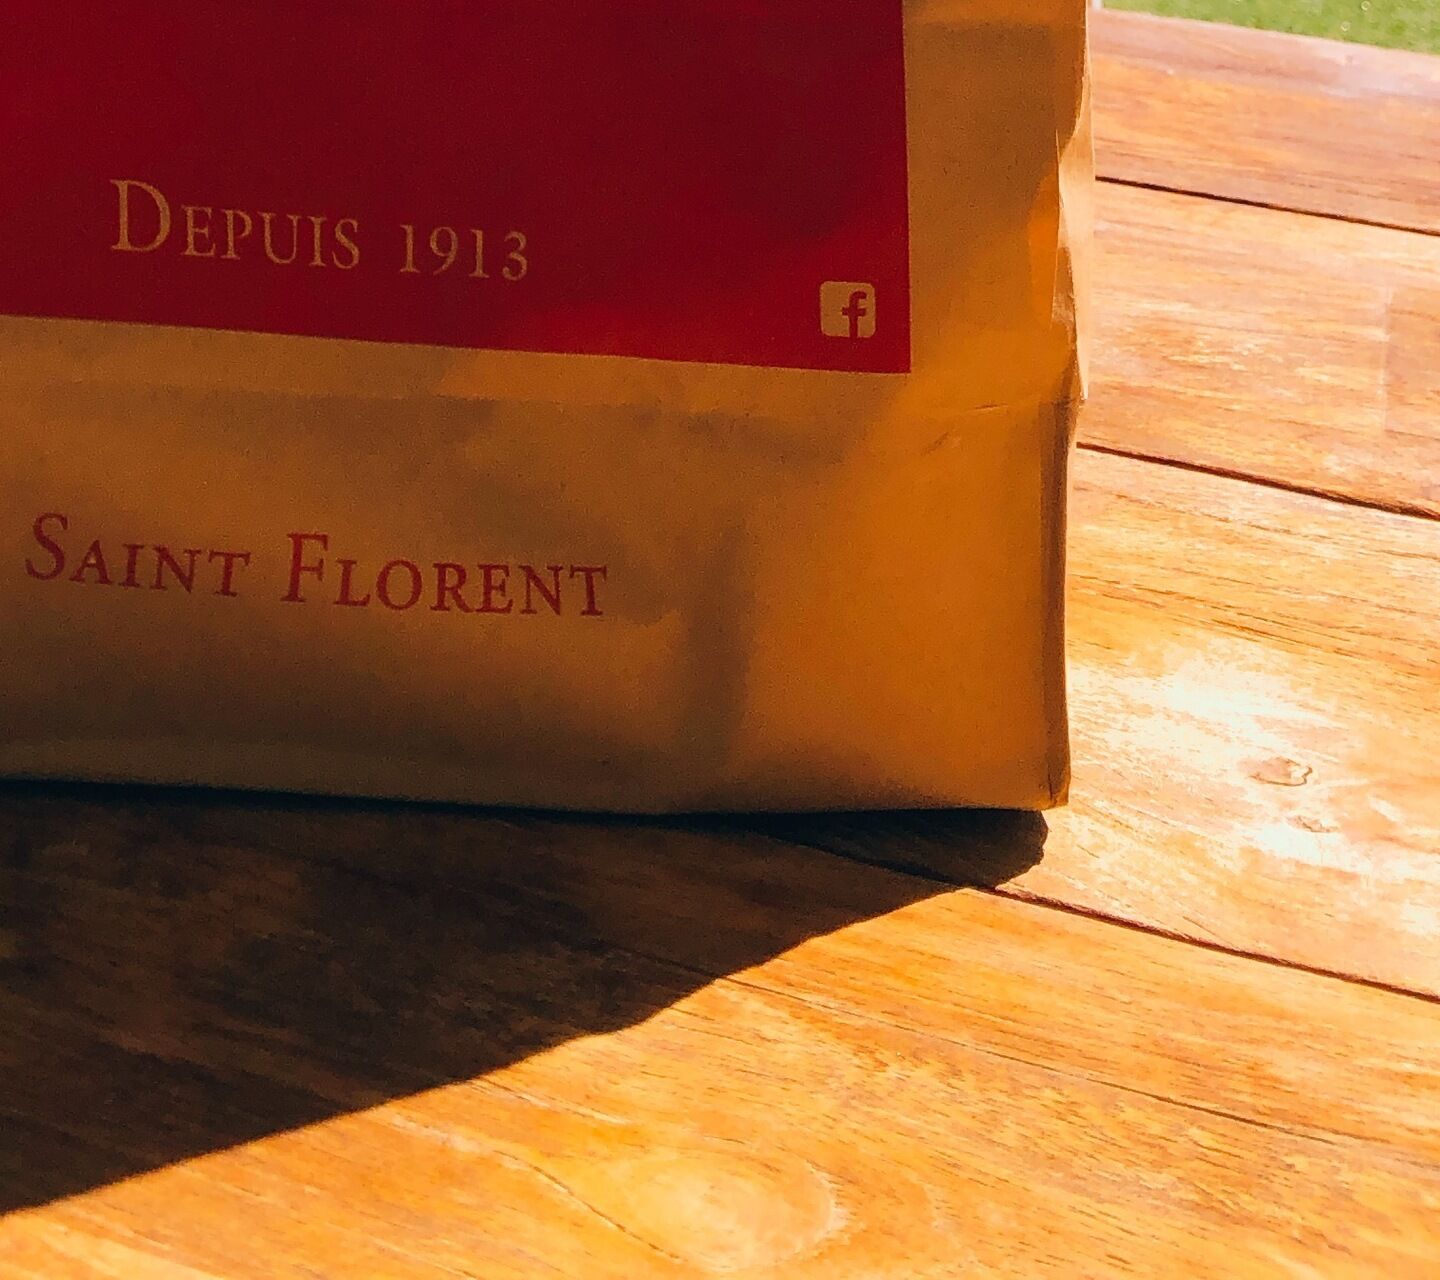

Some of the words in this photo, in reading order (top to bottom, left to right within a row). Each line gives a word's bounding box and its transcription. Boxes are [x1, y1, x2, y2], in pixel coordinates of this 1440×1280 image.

[110, 178, 361, 270] DEPUIS
[398, 223, 530, 281] 1913
[25, 512, 252, 597] SAINT
[282, 532, 609, 617] FLORENT
